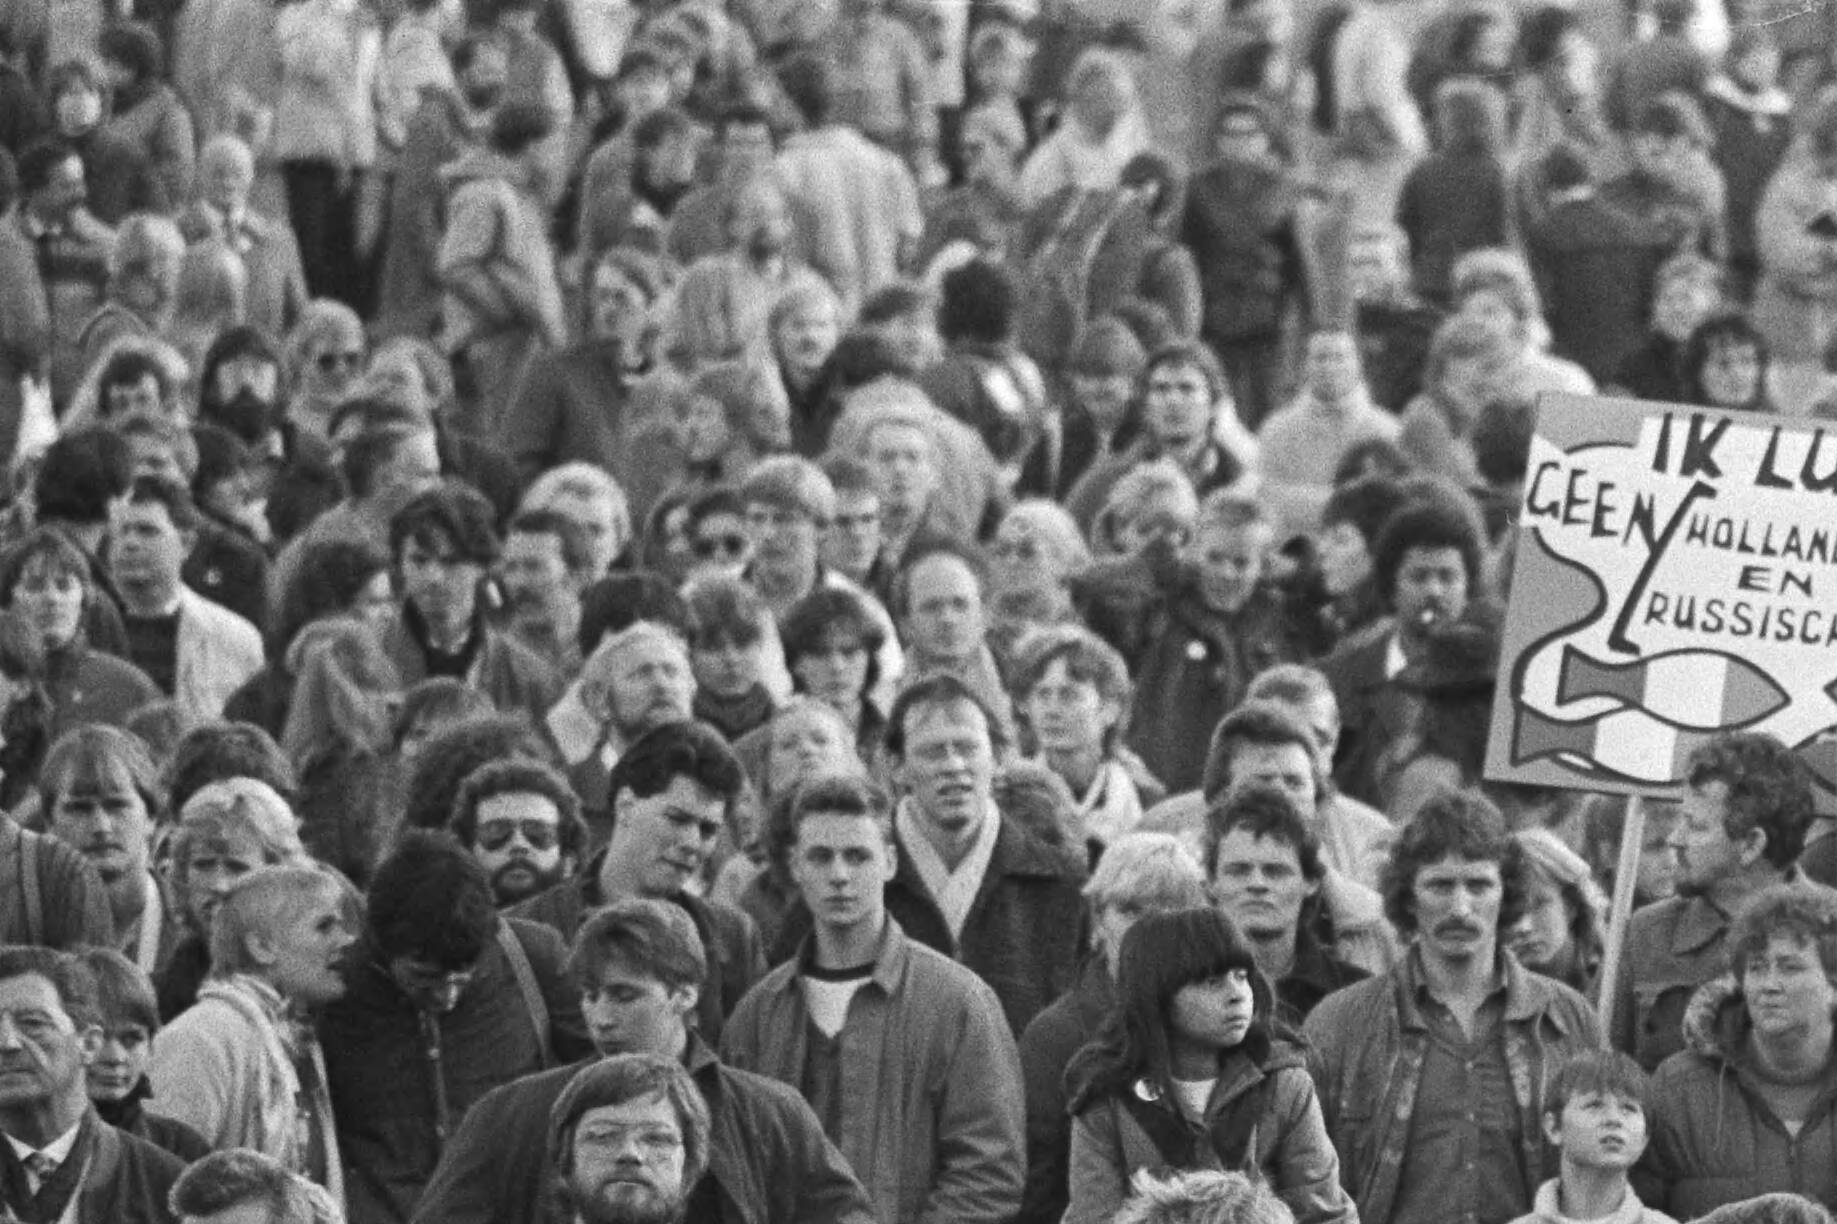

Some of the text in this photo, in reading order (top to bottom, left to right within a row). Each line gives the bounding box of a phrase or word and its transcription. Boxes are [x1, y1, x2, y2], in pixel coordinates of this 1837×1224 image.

[1652, 413, 1731, 481] IK
[1526, 460, 1661, 546] GEEN
[1739, 568, 1814, 597] EN
